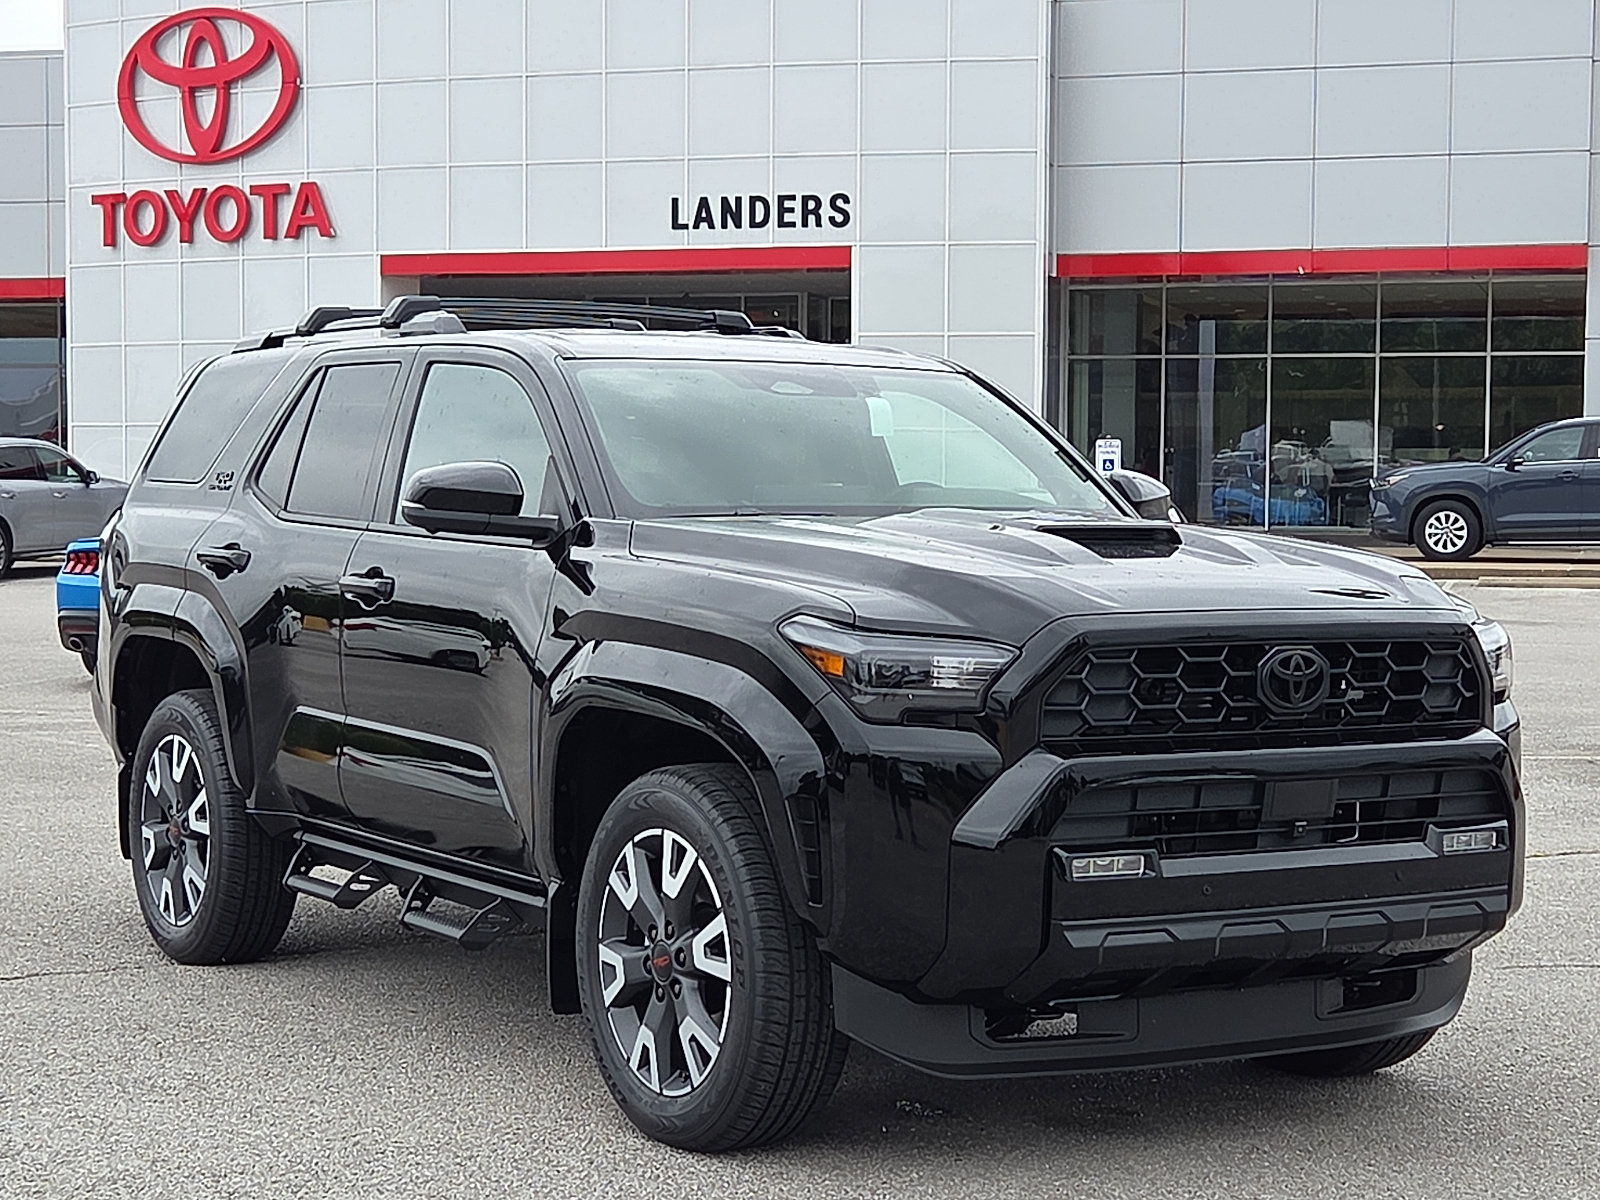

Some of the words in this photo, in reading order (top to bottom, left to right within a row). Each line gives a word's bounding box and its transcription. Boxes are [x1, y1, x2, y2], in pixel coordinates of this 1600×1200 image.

[91, 181, 336, 247] TOYOTA
[671, 193, 851, 230] LANDERS
[705, 843, 746, 990] DUNLOP
